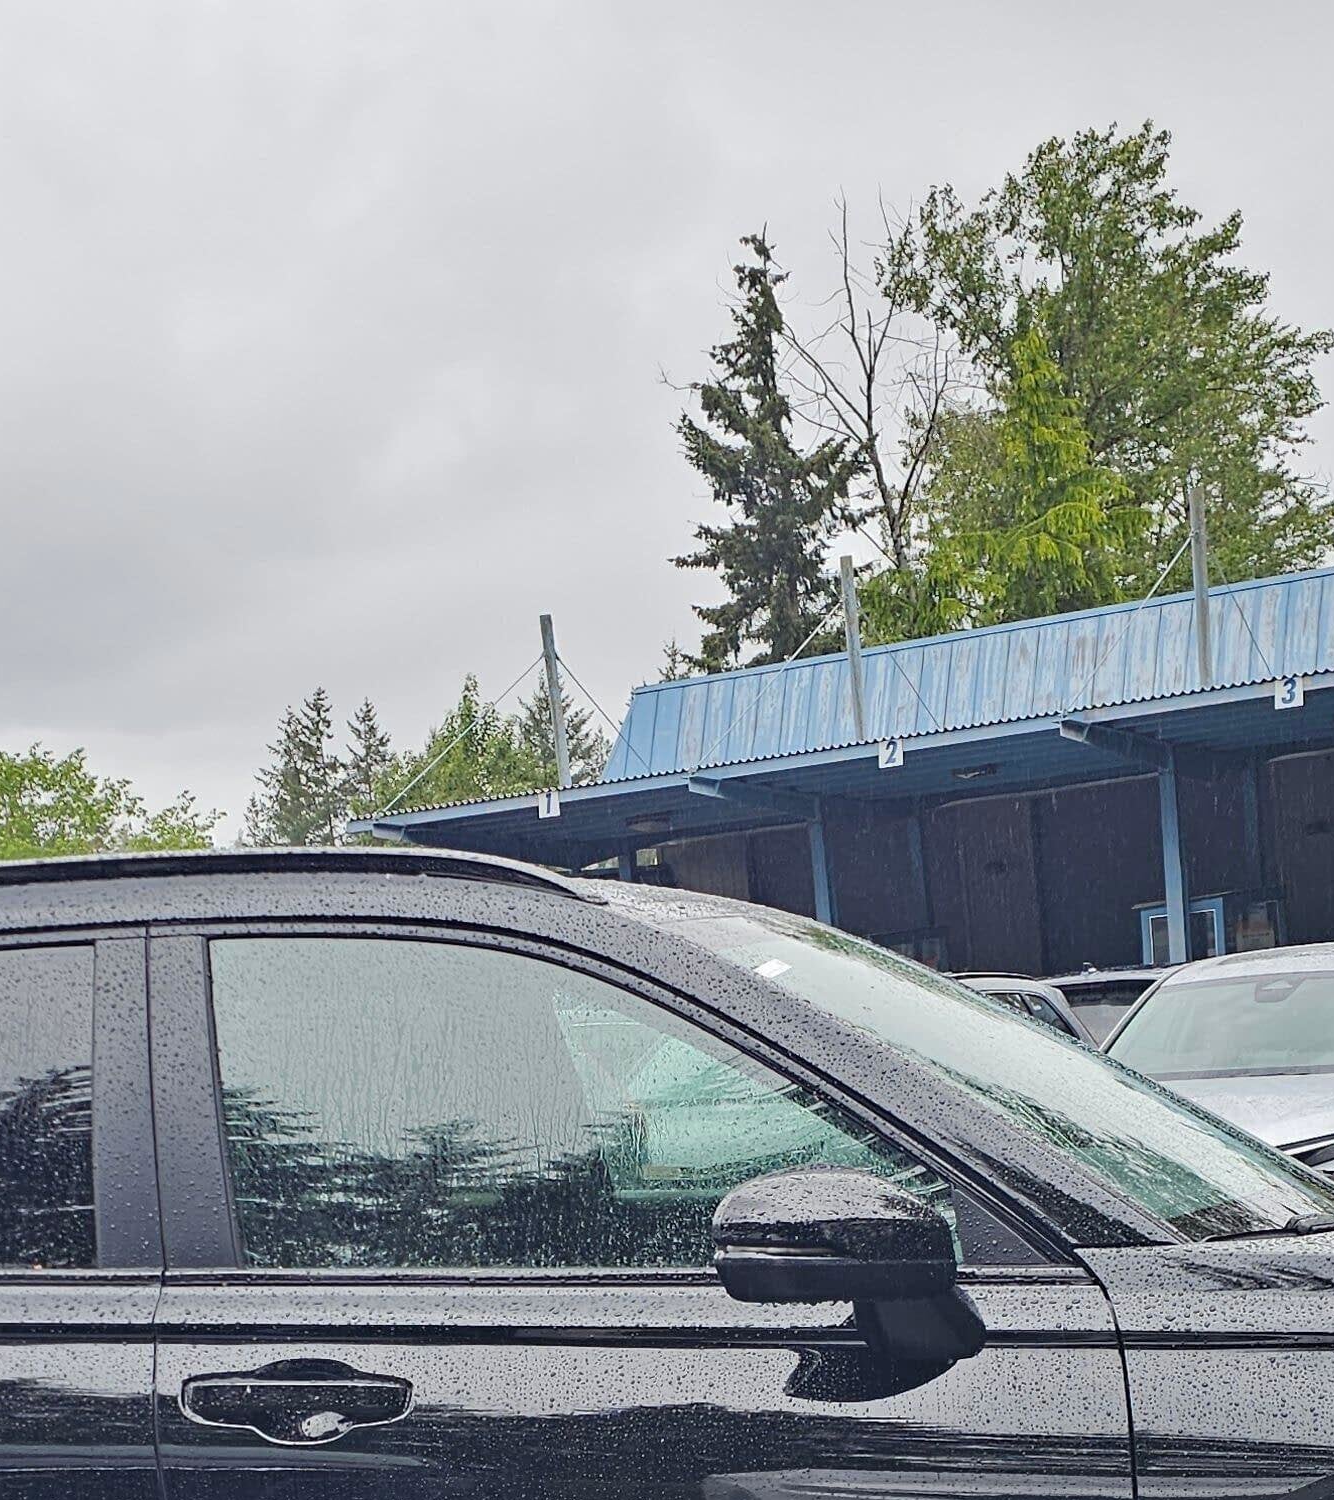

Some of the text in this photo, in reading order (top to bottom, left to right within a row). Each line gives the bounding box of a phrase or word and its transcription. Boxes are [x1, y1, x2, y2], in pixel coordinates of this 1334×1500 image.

[1282, 678, 1297, 704] 3
[884, 740, 898, 764] 2
[545, 792, 552, 814] 1
